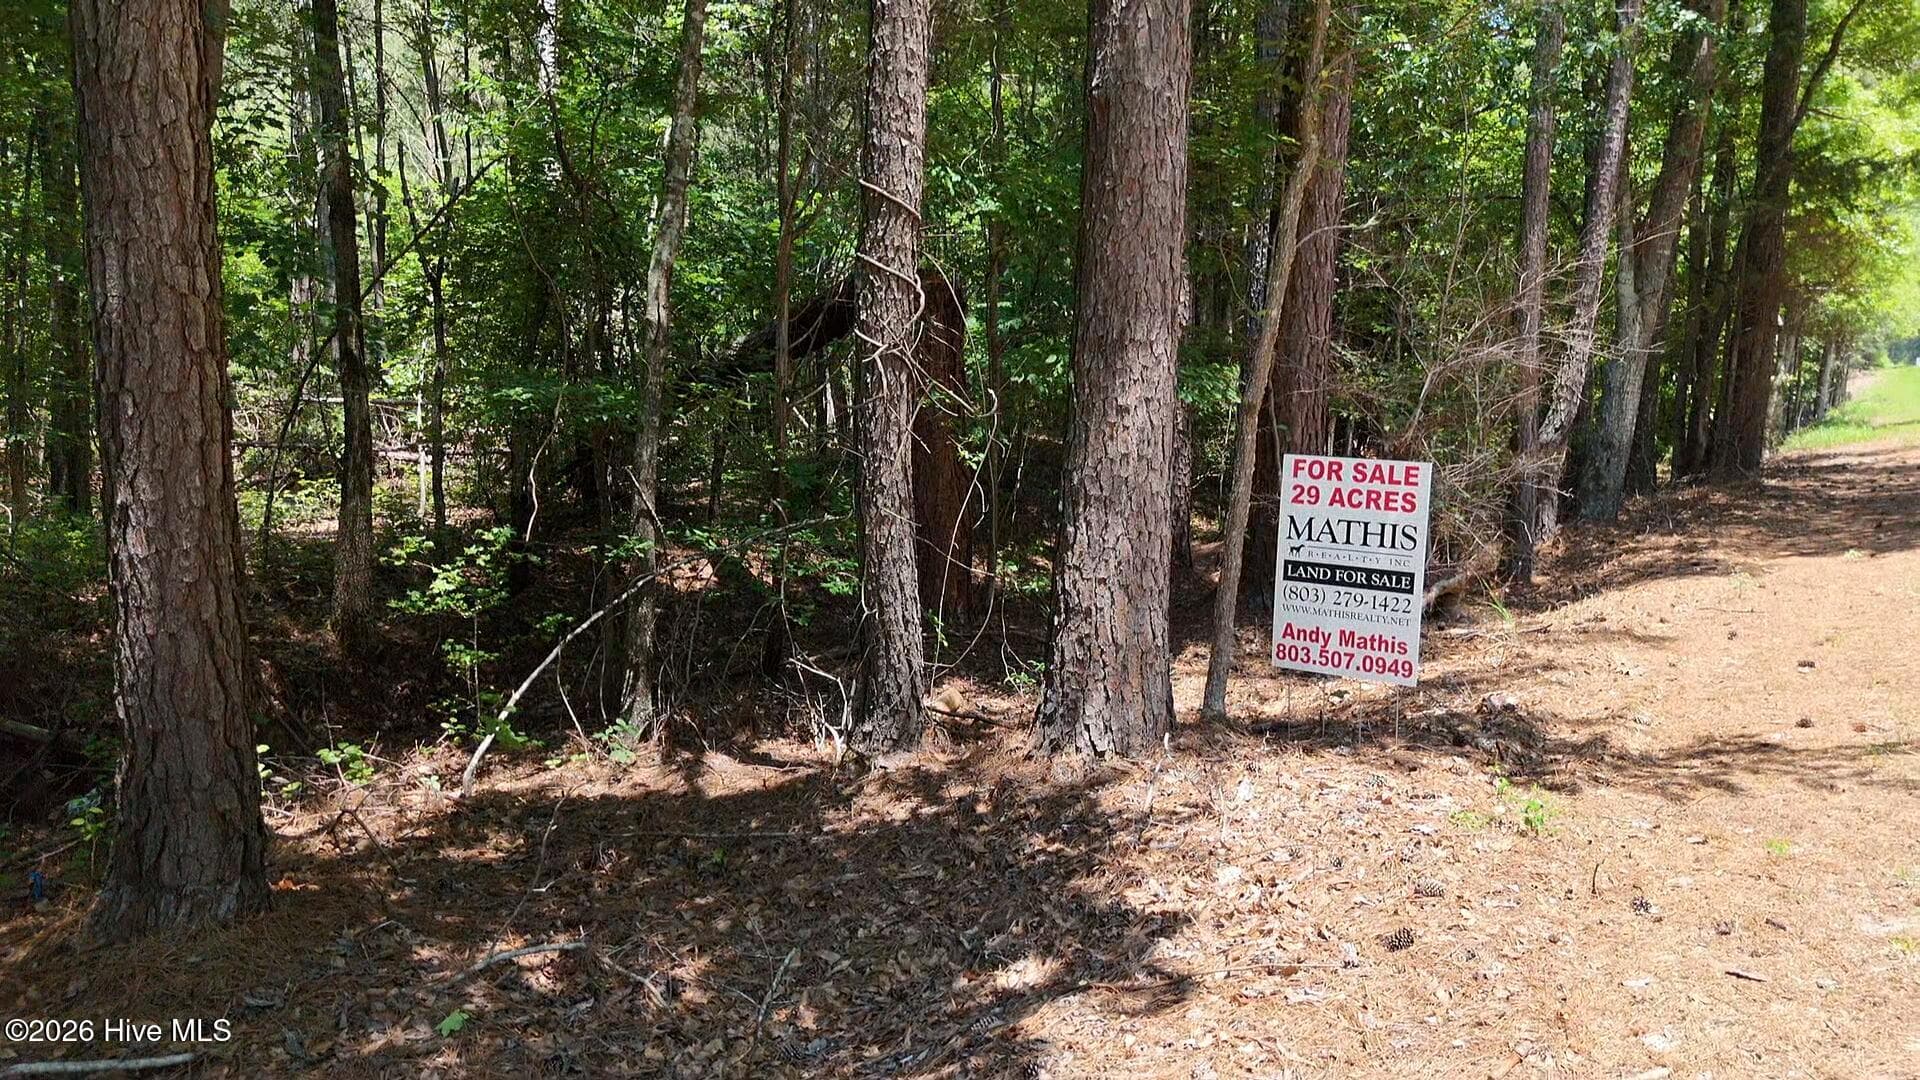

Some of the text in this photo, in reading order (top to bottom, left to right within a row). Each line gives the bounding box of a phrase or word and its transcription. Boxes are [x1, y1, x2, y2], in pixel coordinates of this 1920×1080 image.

[1293, 459, 1420, 486] FOR SALE
[1291, 484, 1417, 513] 29 ACRES
[1286, 515, 1418, 551] MATHIS
[1287, 564, 1411, 589] LAND FOR SALE
[1283, 584, 1412, 614] (803) 279-1422
[1282, 603, 1411, 627] WWW.MATHISREALTY.NET
[1281, 622, 1408, 655] Andy Mathis
[1275, 643, 1413, 679] 803.507.0949
